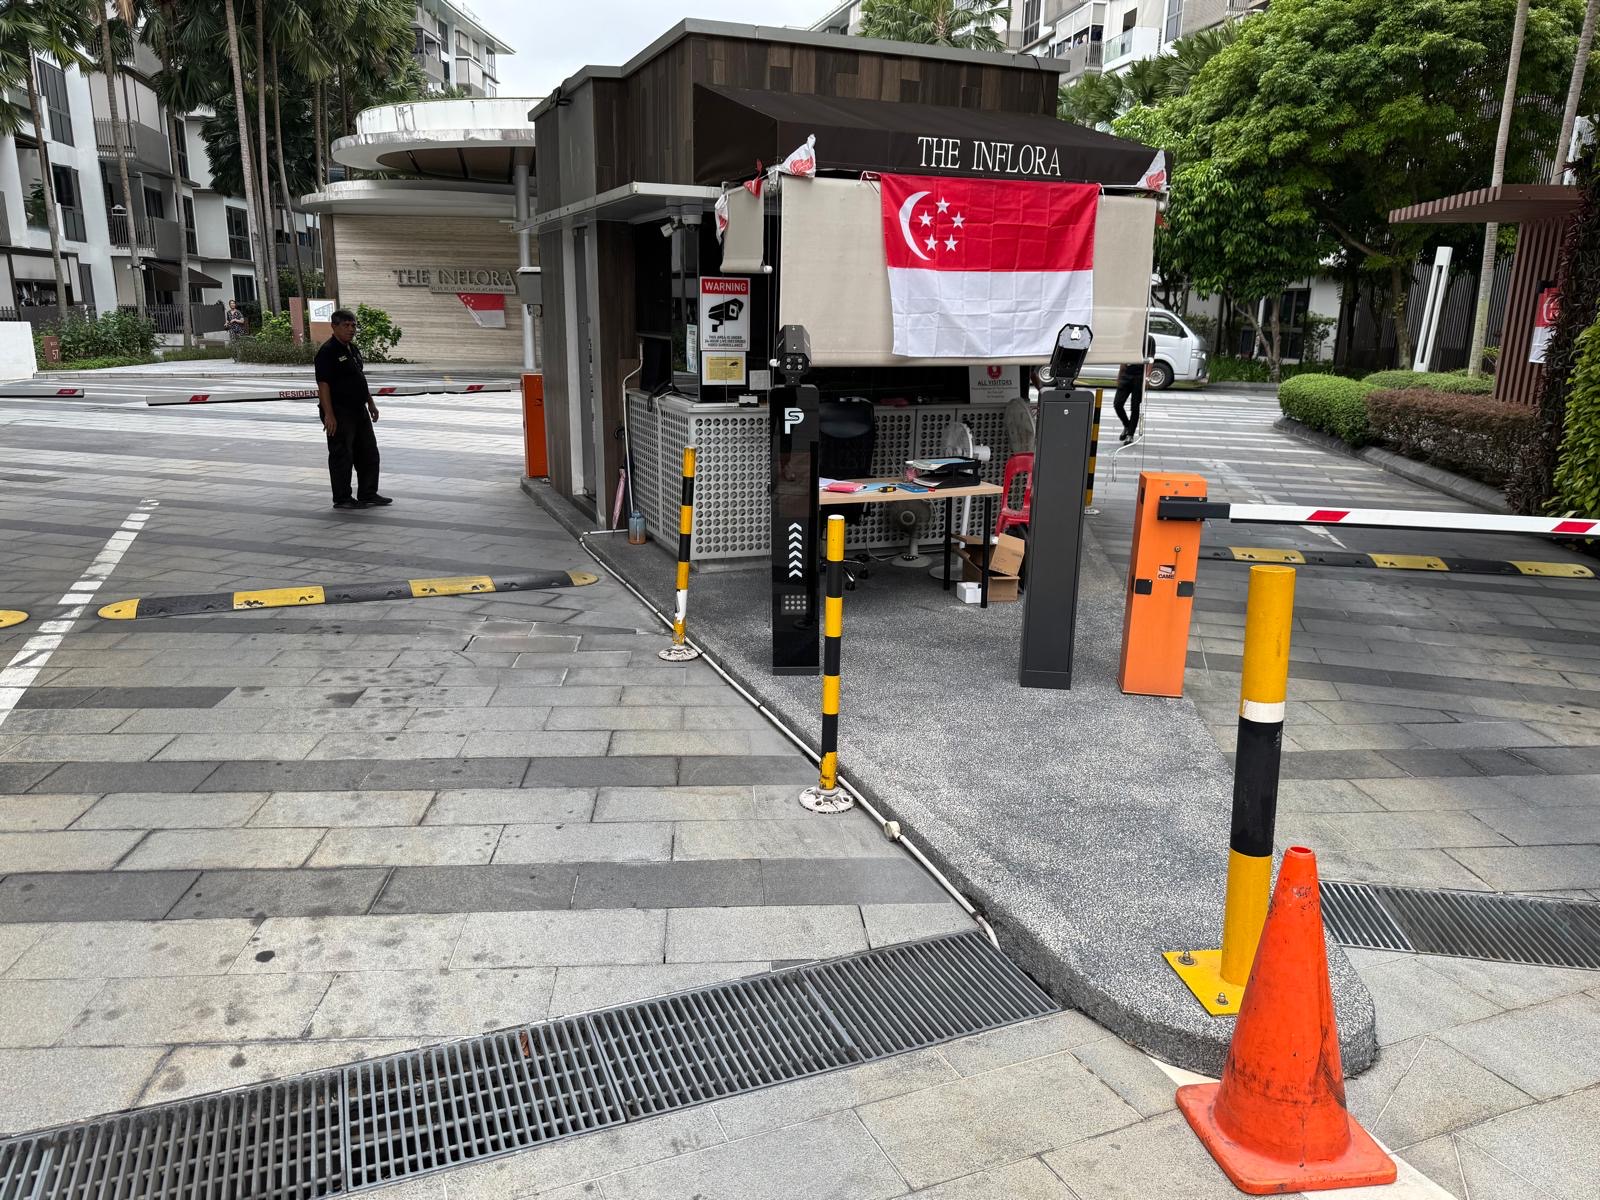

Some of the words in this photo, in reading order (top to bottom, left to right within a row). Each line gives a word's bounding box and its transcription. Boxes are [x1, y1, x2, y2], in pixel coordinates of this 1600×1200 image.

[917, 136, 961, 169] THE
[971, 140, 1062, 176] INFLORA
[392, 269, 430, 284] THE
[438, 269, 516, 286] INFLORA
[704, 281, 747, 292] WARNING
[52, 349, 59, 360] 57
